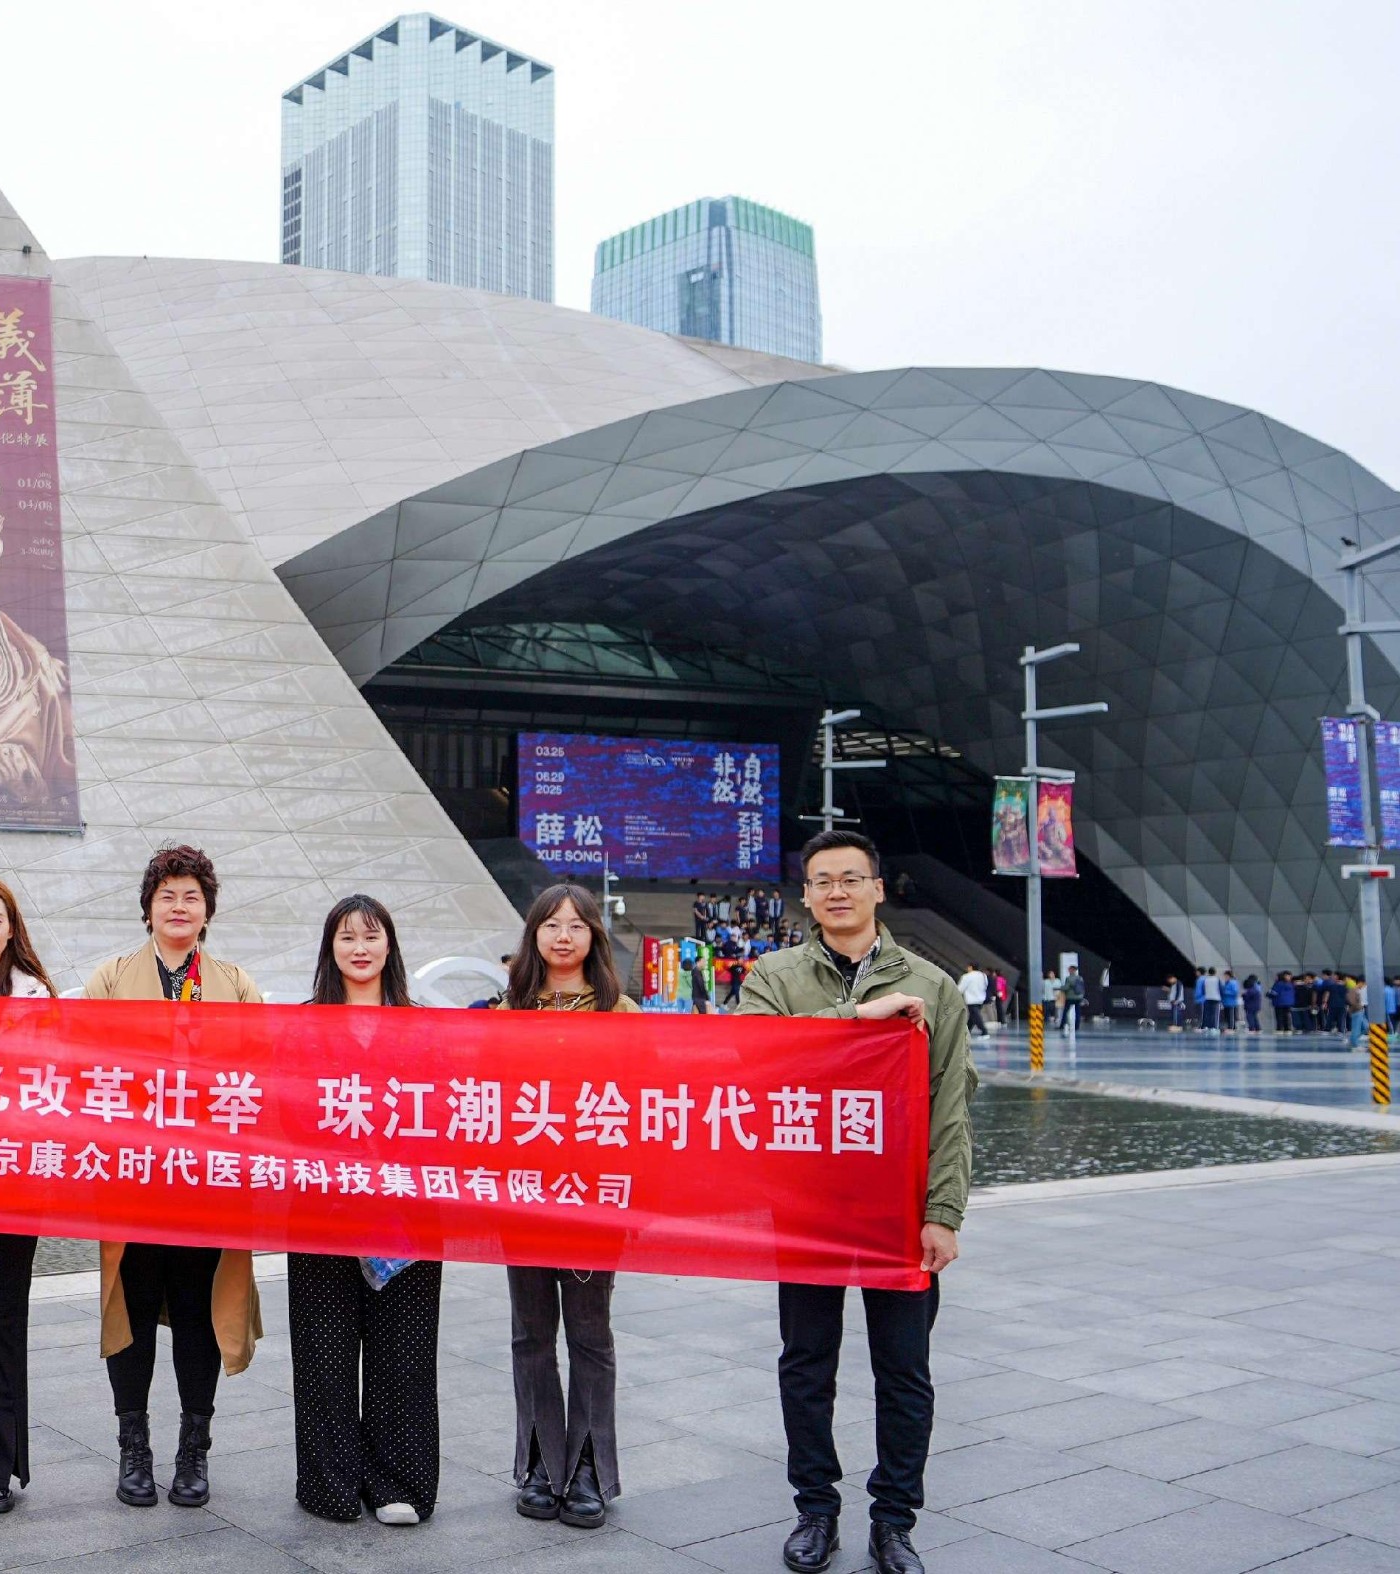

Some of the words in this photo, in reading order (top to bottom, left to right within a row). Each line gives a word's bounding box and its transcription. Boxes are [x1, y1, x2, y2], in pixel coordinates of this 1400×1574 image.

[17, 478, 52, 490] 01/08
[535, 746, 565, 757] 03.25
[535, 784, 563, 795] 2025
[736, 811, 751, 869] NATURE
[536, 849, 563, 861] XUE
[564, 850, 603, 863] SONG
[317, 1072, 885, 1156] 珠江潮头绘时代蓝图
